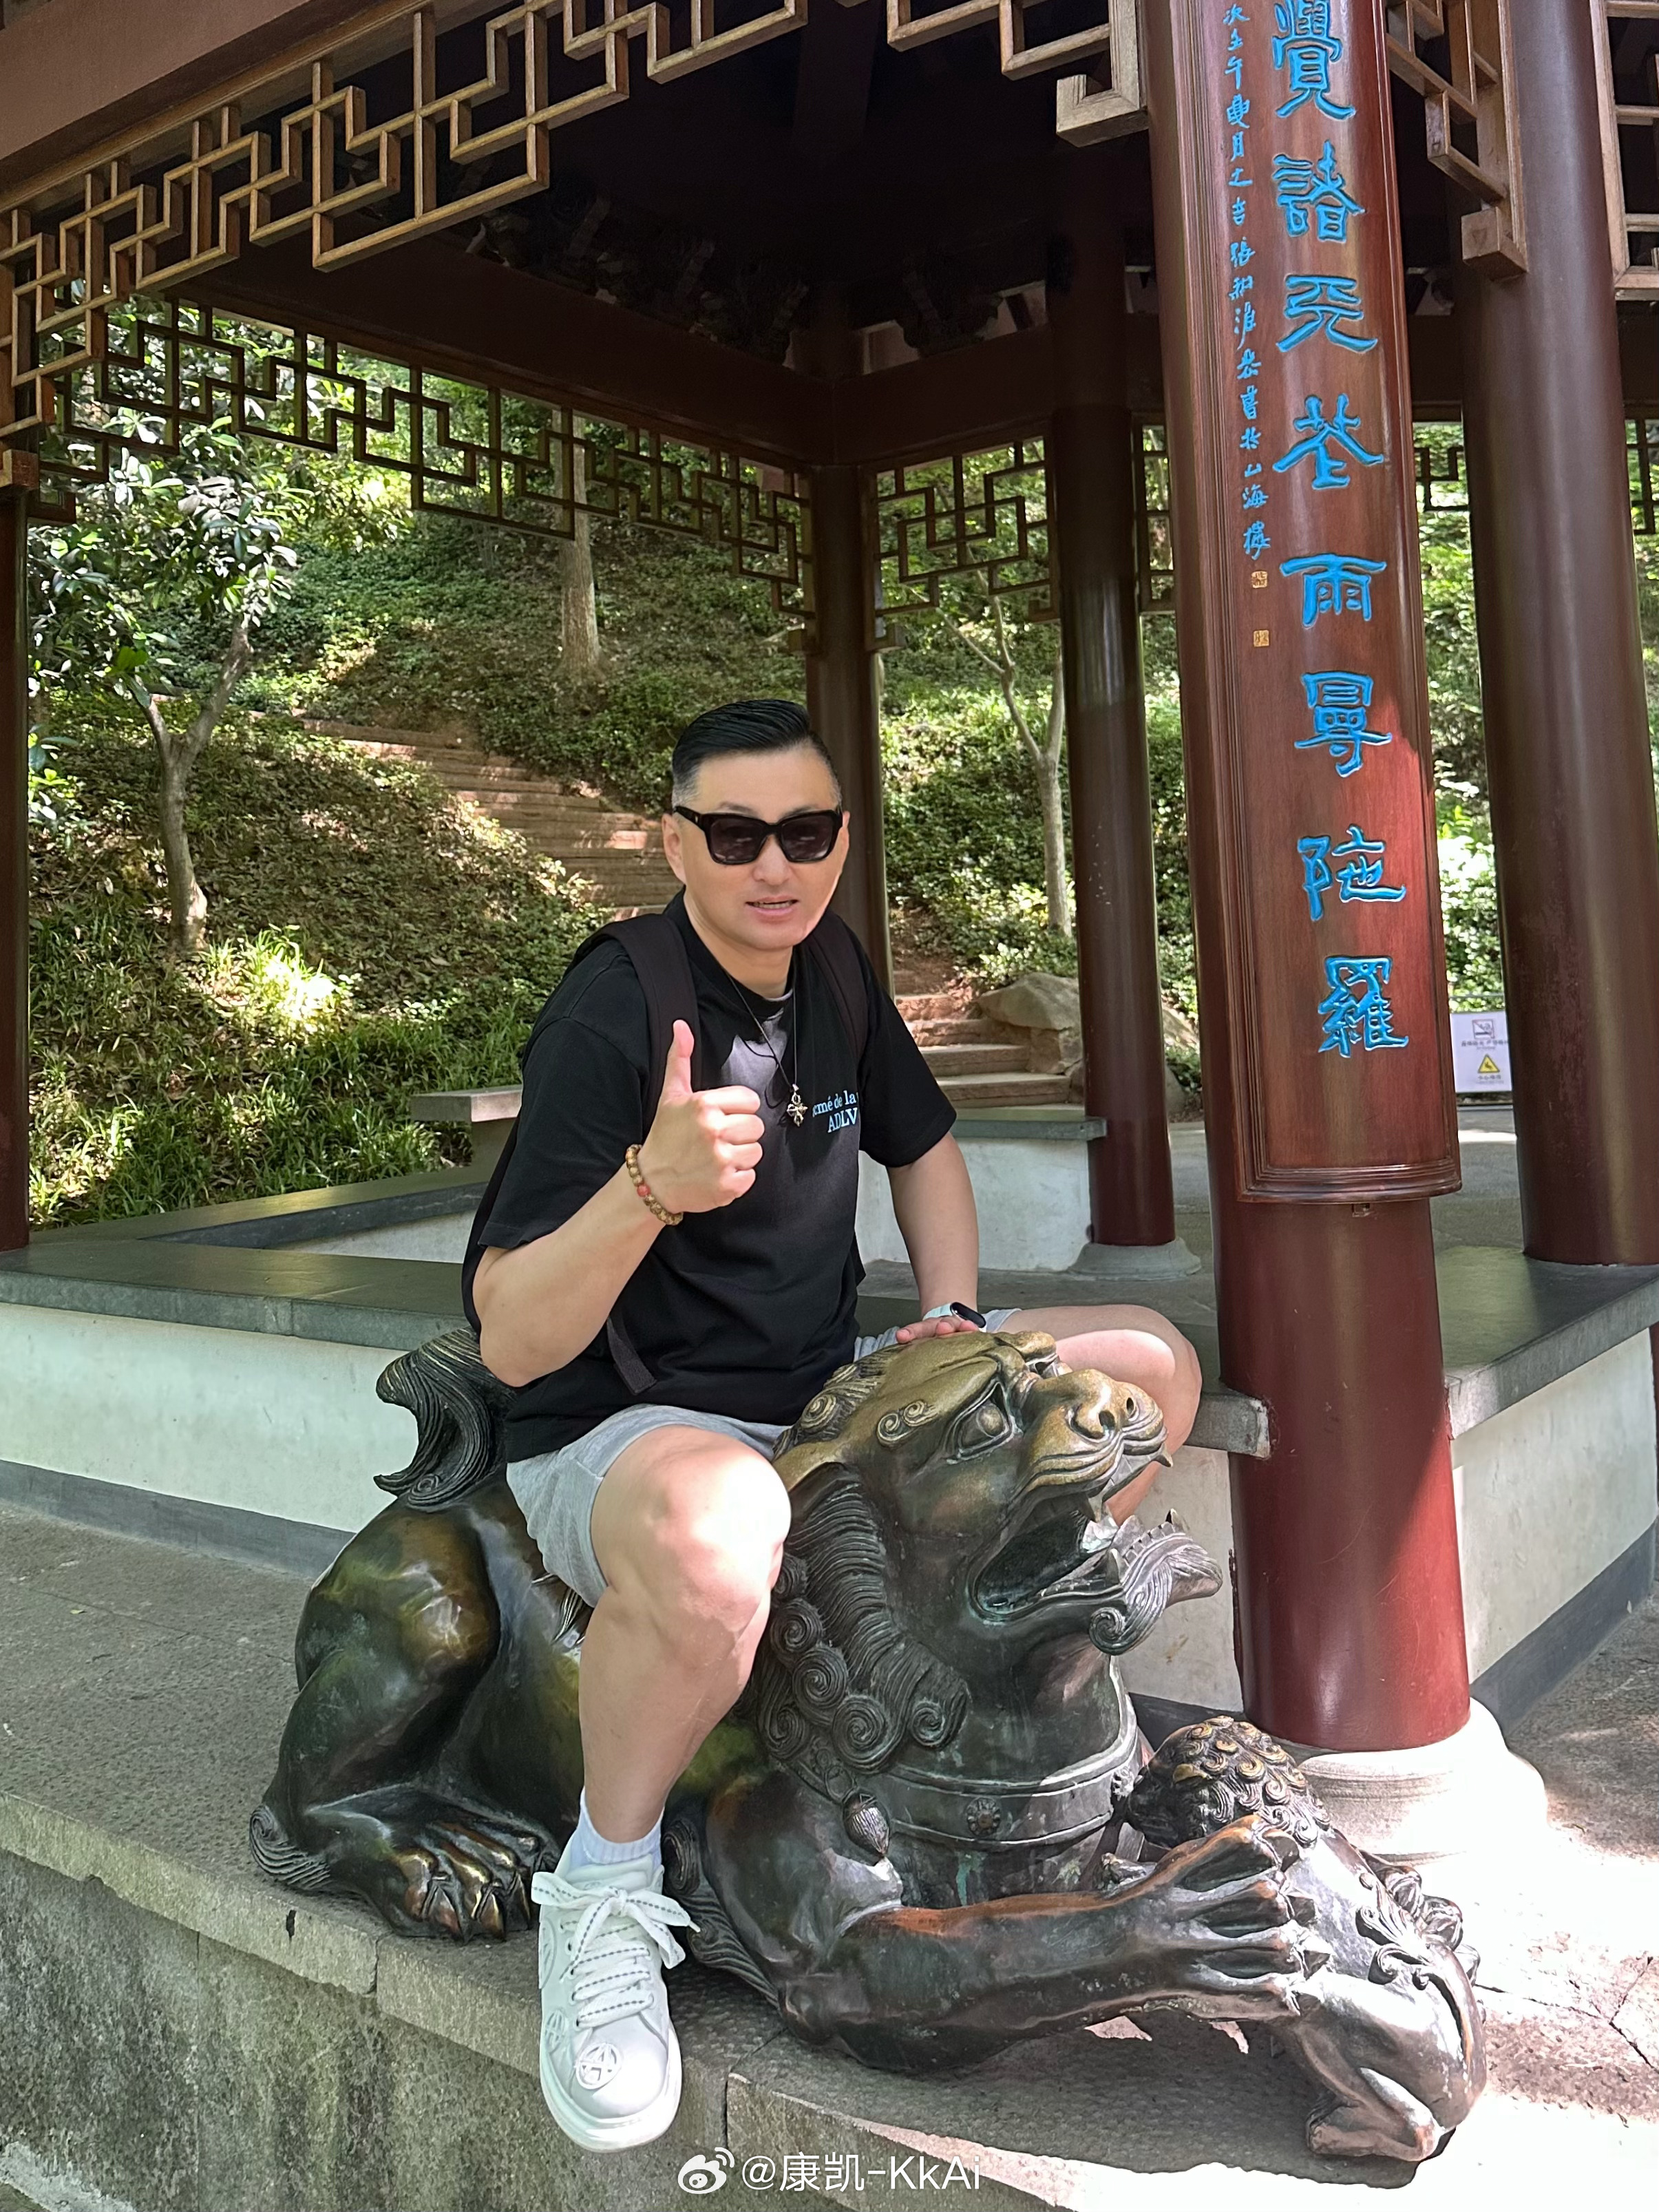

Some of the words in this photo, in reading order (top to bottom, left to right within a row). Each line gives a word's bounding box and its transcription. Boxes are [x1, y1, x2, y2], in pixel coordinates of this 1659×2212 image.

[812, 1095, 833, 1117] cmé
[834, 1093, 843, 1109] de
[843, 1090, 856, 1105] la
[827, 1107, 858, 1133] ADLV
